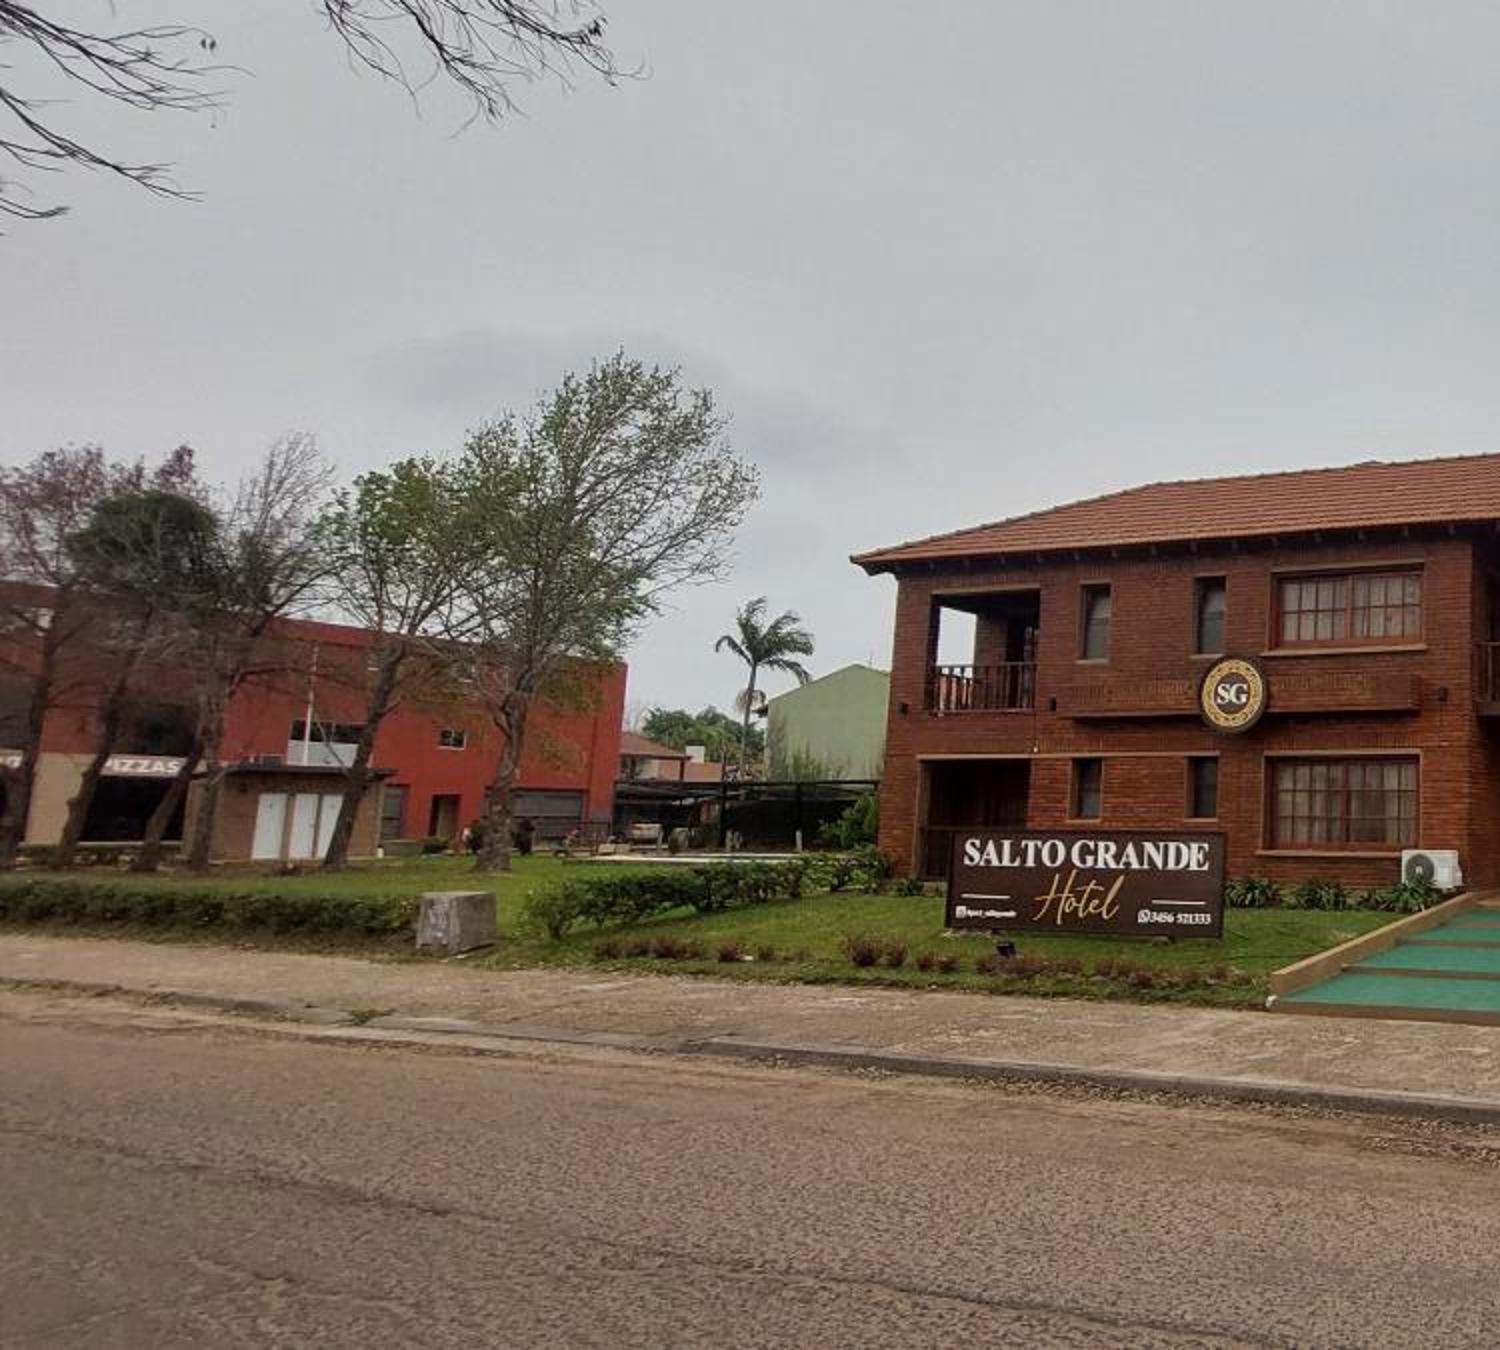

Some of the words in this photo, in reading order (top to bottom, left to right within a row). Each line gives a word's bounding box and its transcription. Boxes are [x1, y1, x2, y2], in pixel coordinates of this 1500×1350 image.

[1217, 683, 1249, 705] SG
[963, 838, 1066, 868] SALTO
[1071, 839, 1210, 871] GRANDE
[1032, 868, 1125, 925] Hotel
